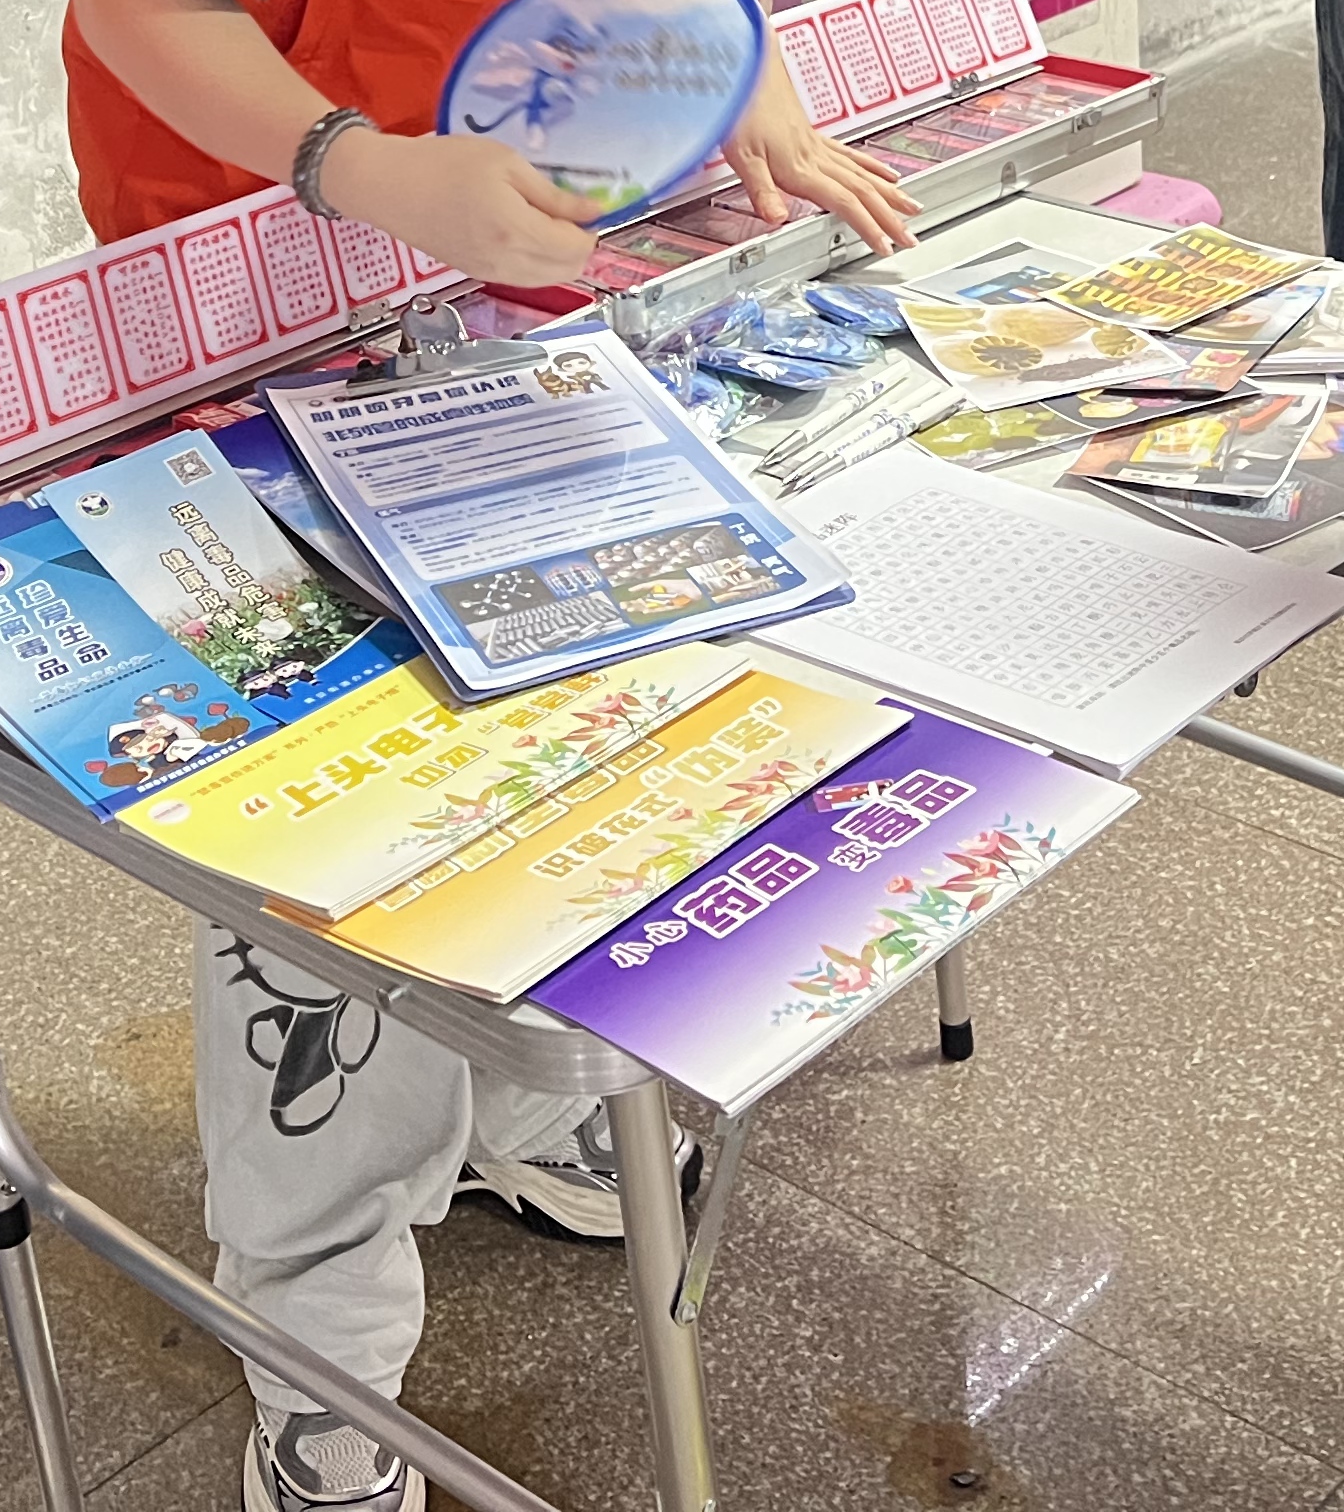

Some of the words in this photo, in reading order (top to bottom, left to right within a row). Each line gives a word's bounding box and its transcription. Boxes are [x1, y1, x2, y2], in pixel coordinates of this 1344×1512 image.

[158, 546, 283, 660] 健康成就未来
[171, 500, 289, 626] 远离毒品危害
[15, 579, 111, 665] 珍爱生命
